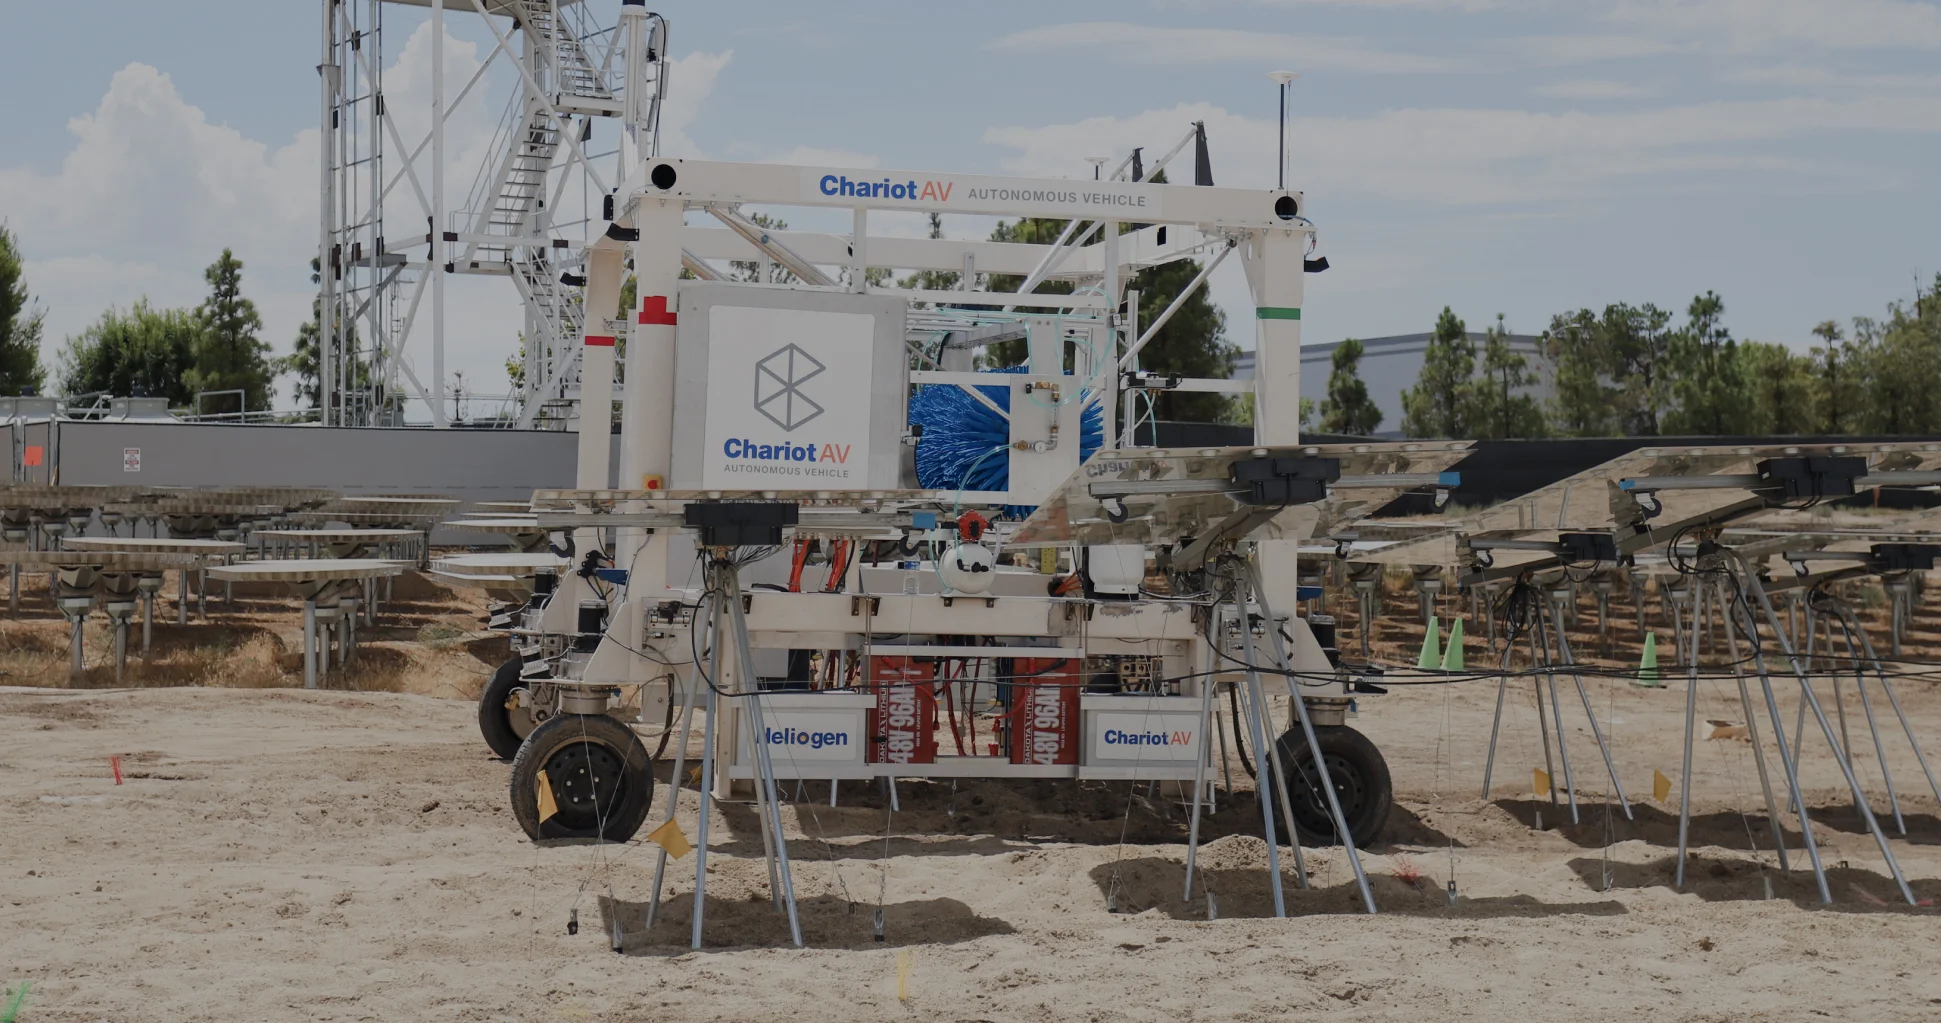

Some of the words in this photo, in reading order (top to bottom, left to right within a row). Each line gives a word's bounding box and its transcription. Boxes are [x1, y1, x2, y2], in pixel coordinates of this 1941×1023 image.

[819, 174, 917, 201] Chariot
[919, 181, 953, 202] AV
[968, 187, 1077, 203] AUTONOMOUS
[1082, 192, 1146, 207] VEHICLE
[724, 438, 816, 462] Chariot
[819, 443, 851, 464] AV
[724, 465, 801, 475] AUTONOMOUS
[804, 468, 849, 478] VEHICLE
[888, 730, 914, 764] 48V
[1033, 730, 1059, 765] 48V
[1104, 729, 1169, 746] Chariot
[1170, 731, 1192, 746] AV
